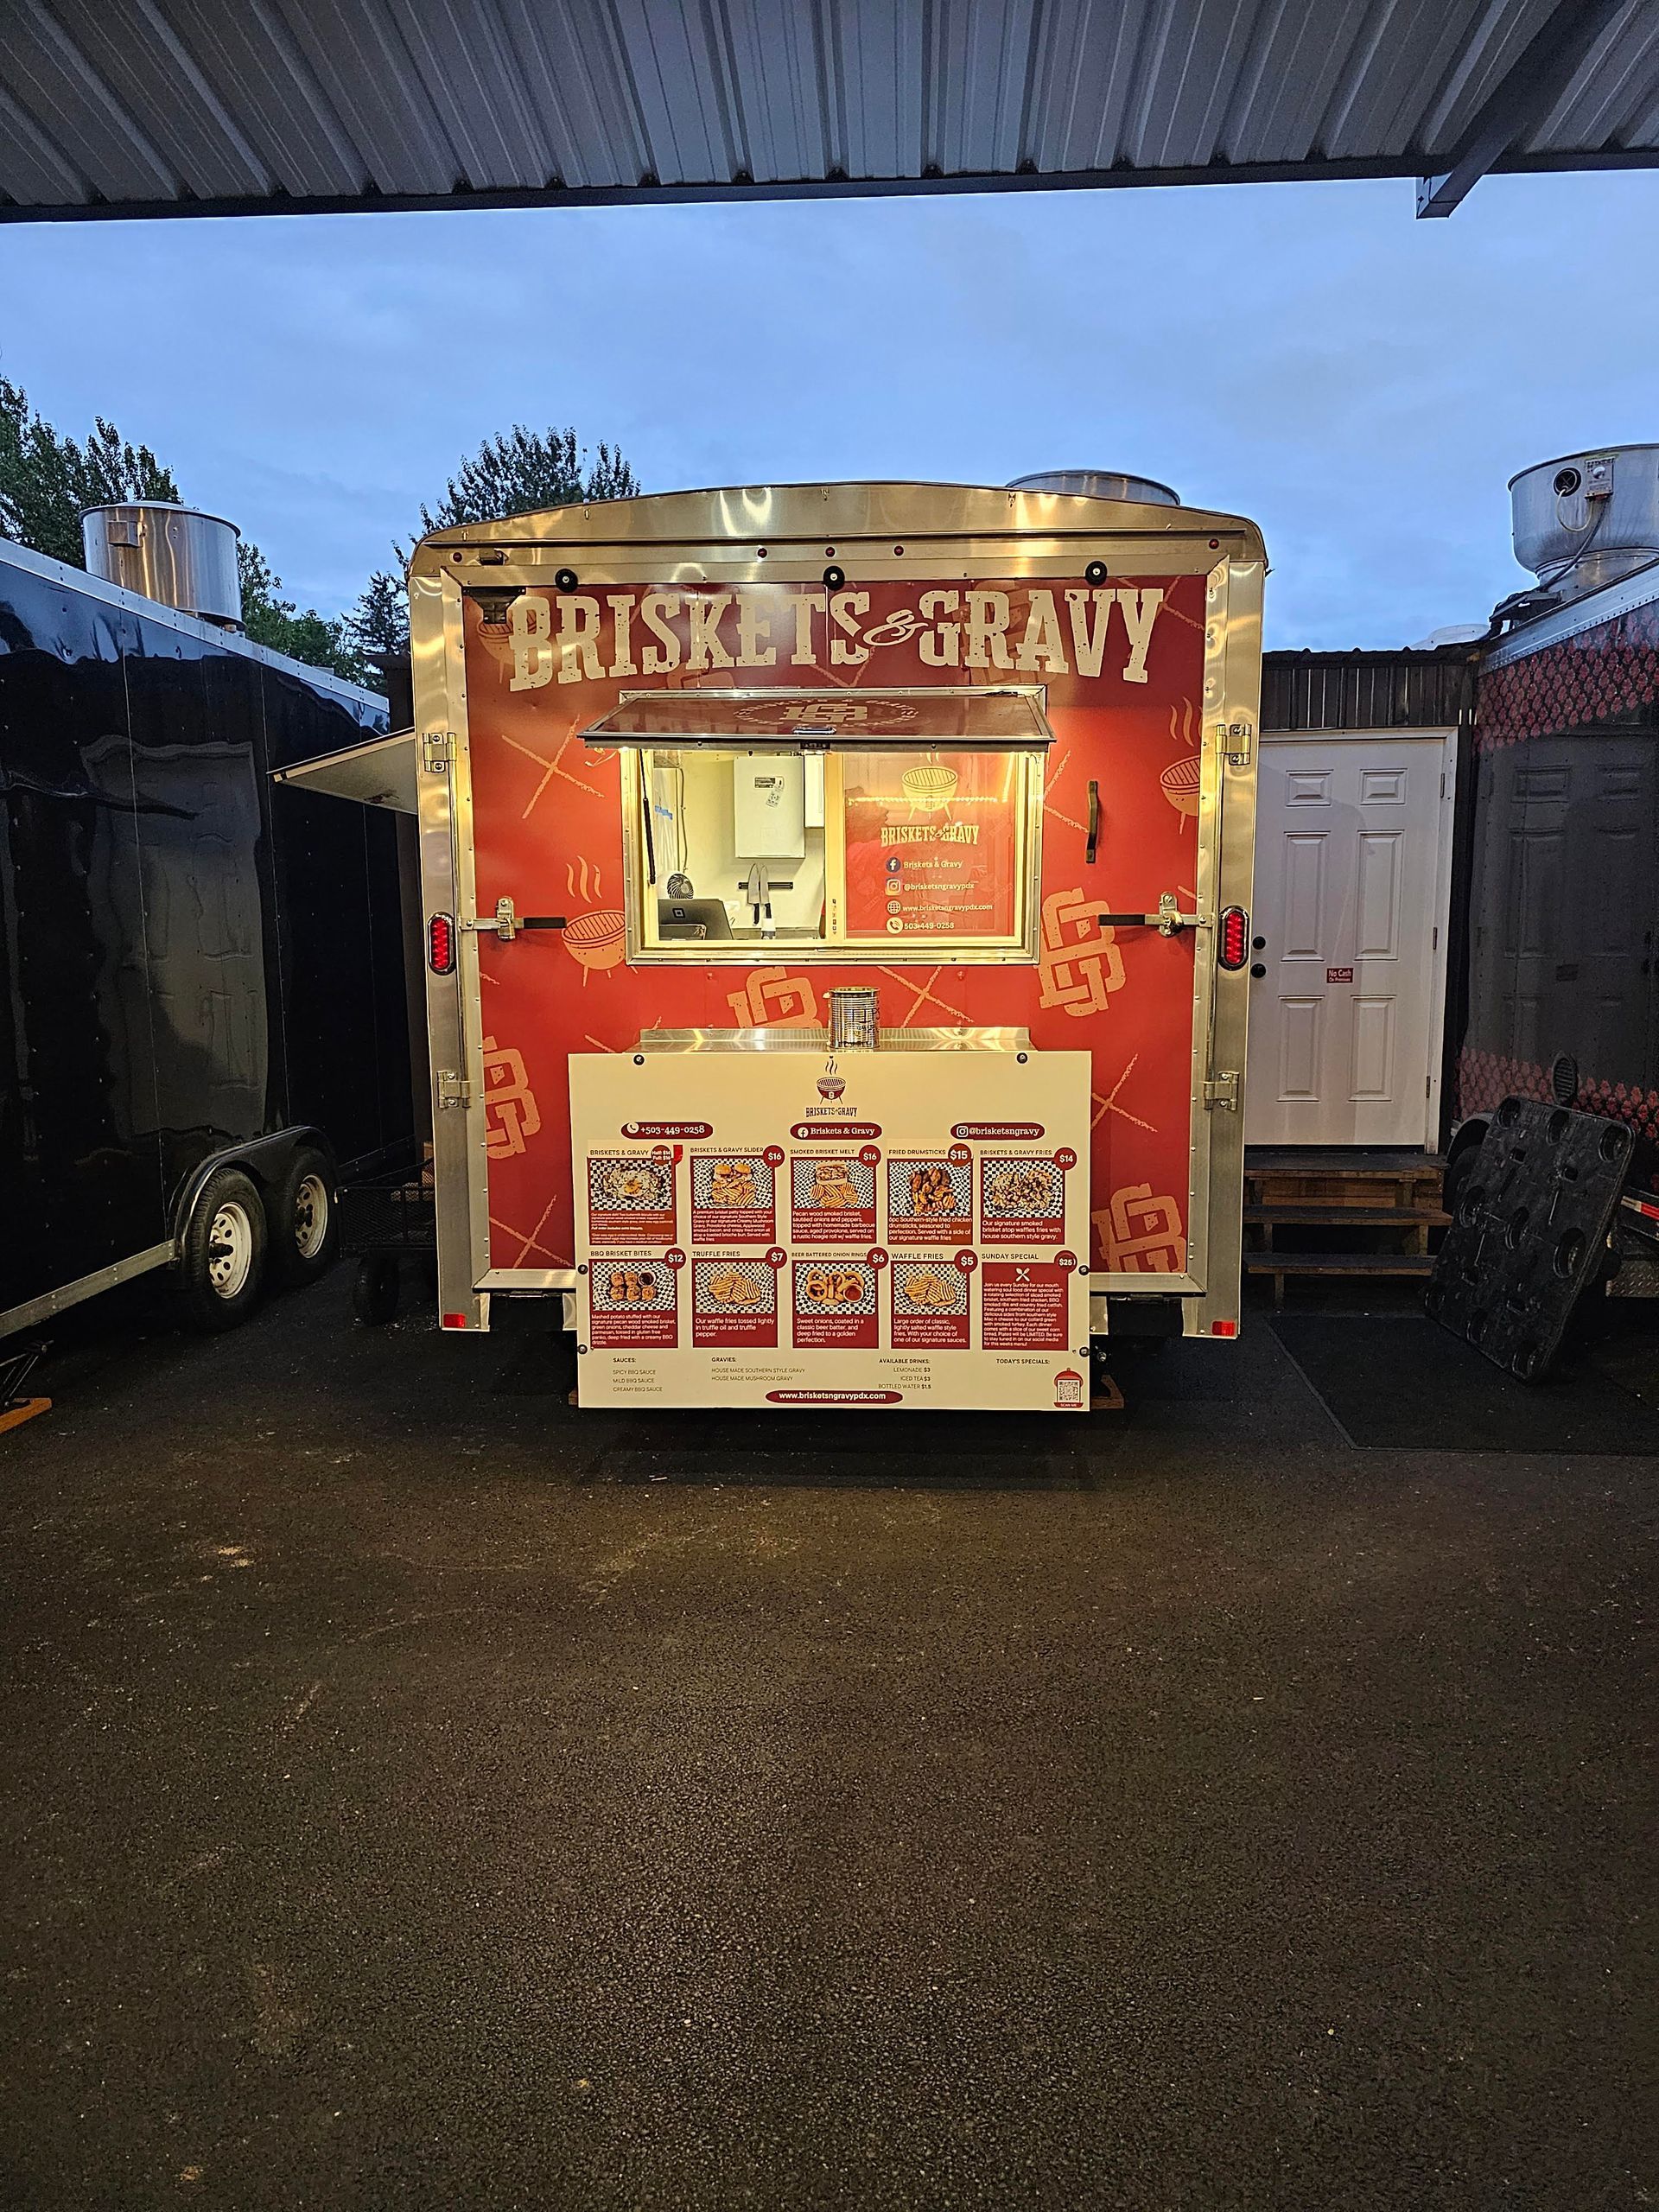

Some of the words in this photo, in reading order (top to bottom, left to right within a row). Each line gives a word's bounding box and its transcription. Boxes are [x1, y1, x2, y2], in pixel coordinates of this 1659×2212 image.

[509, 591, 869, 691] BRISKETS
[863, 609, 929, 646] &
[918, 588, 1164, 683] GRAVY
[880, 826, 937, 847] BRISKETS
[940, 824, 979, 845] GRAVY
[902, 904, 993, 912] www.brisketsngravypdx.com
[805, 1108, 835, 1117] BRISKETS
[837, 1108, 857, 1117] GRAVY
[640, 1125, 705, 1135] +503-449-0258
[969, 1127, 1040, 1137] @brisketsngravy
[950, 1150, 968, 1160] $15
[771, 1253, 783, 1262] $7
[961, 1257, 974, 1266] $5
[779, 1391, 886, 1400] www.brisketsngravypdx.com
